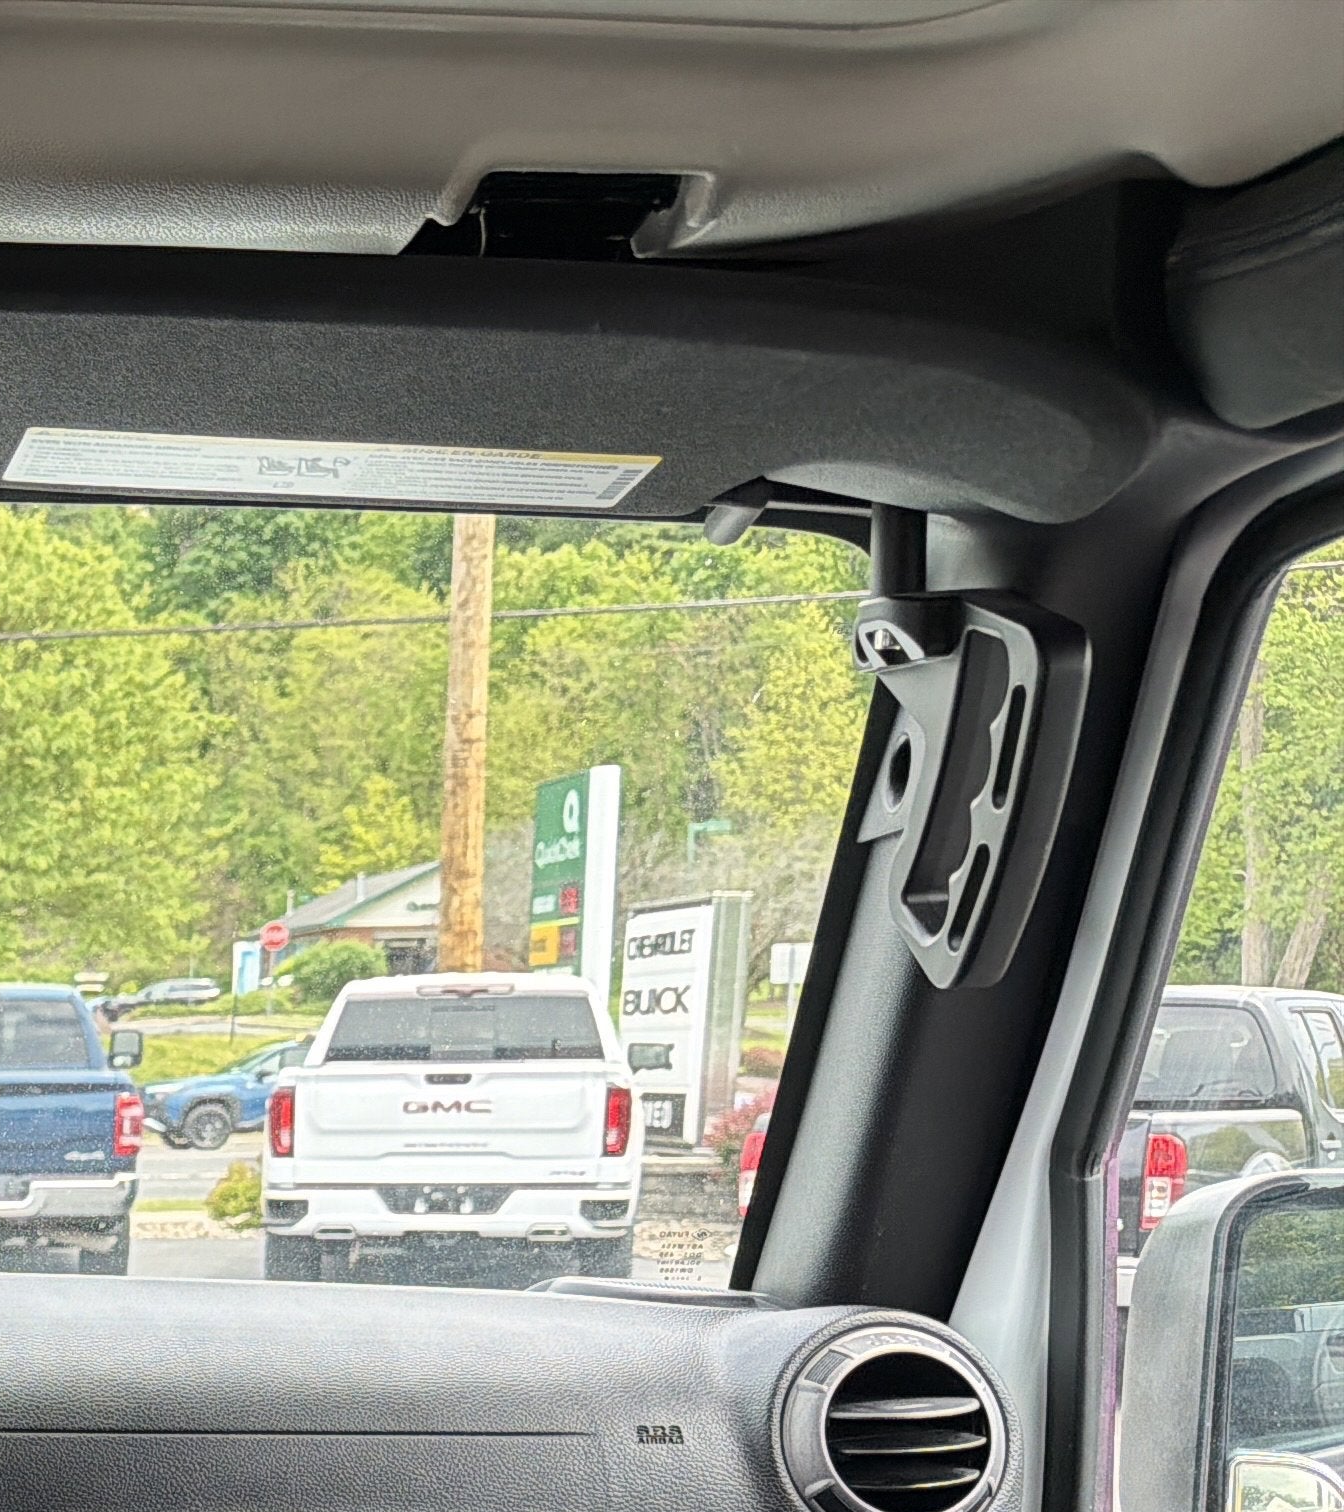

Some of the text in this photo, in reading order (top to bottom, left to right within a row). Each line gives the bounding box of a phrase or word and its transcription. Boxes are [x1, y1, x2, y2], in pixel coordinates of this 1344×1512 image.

[480, 451, 544, 460] GARDE
[622, 984, 691, 1016] BUICK
[402, 1100, 492, 1114] GMC
